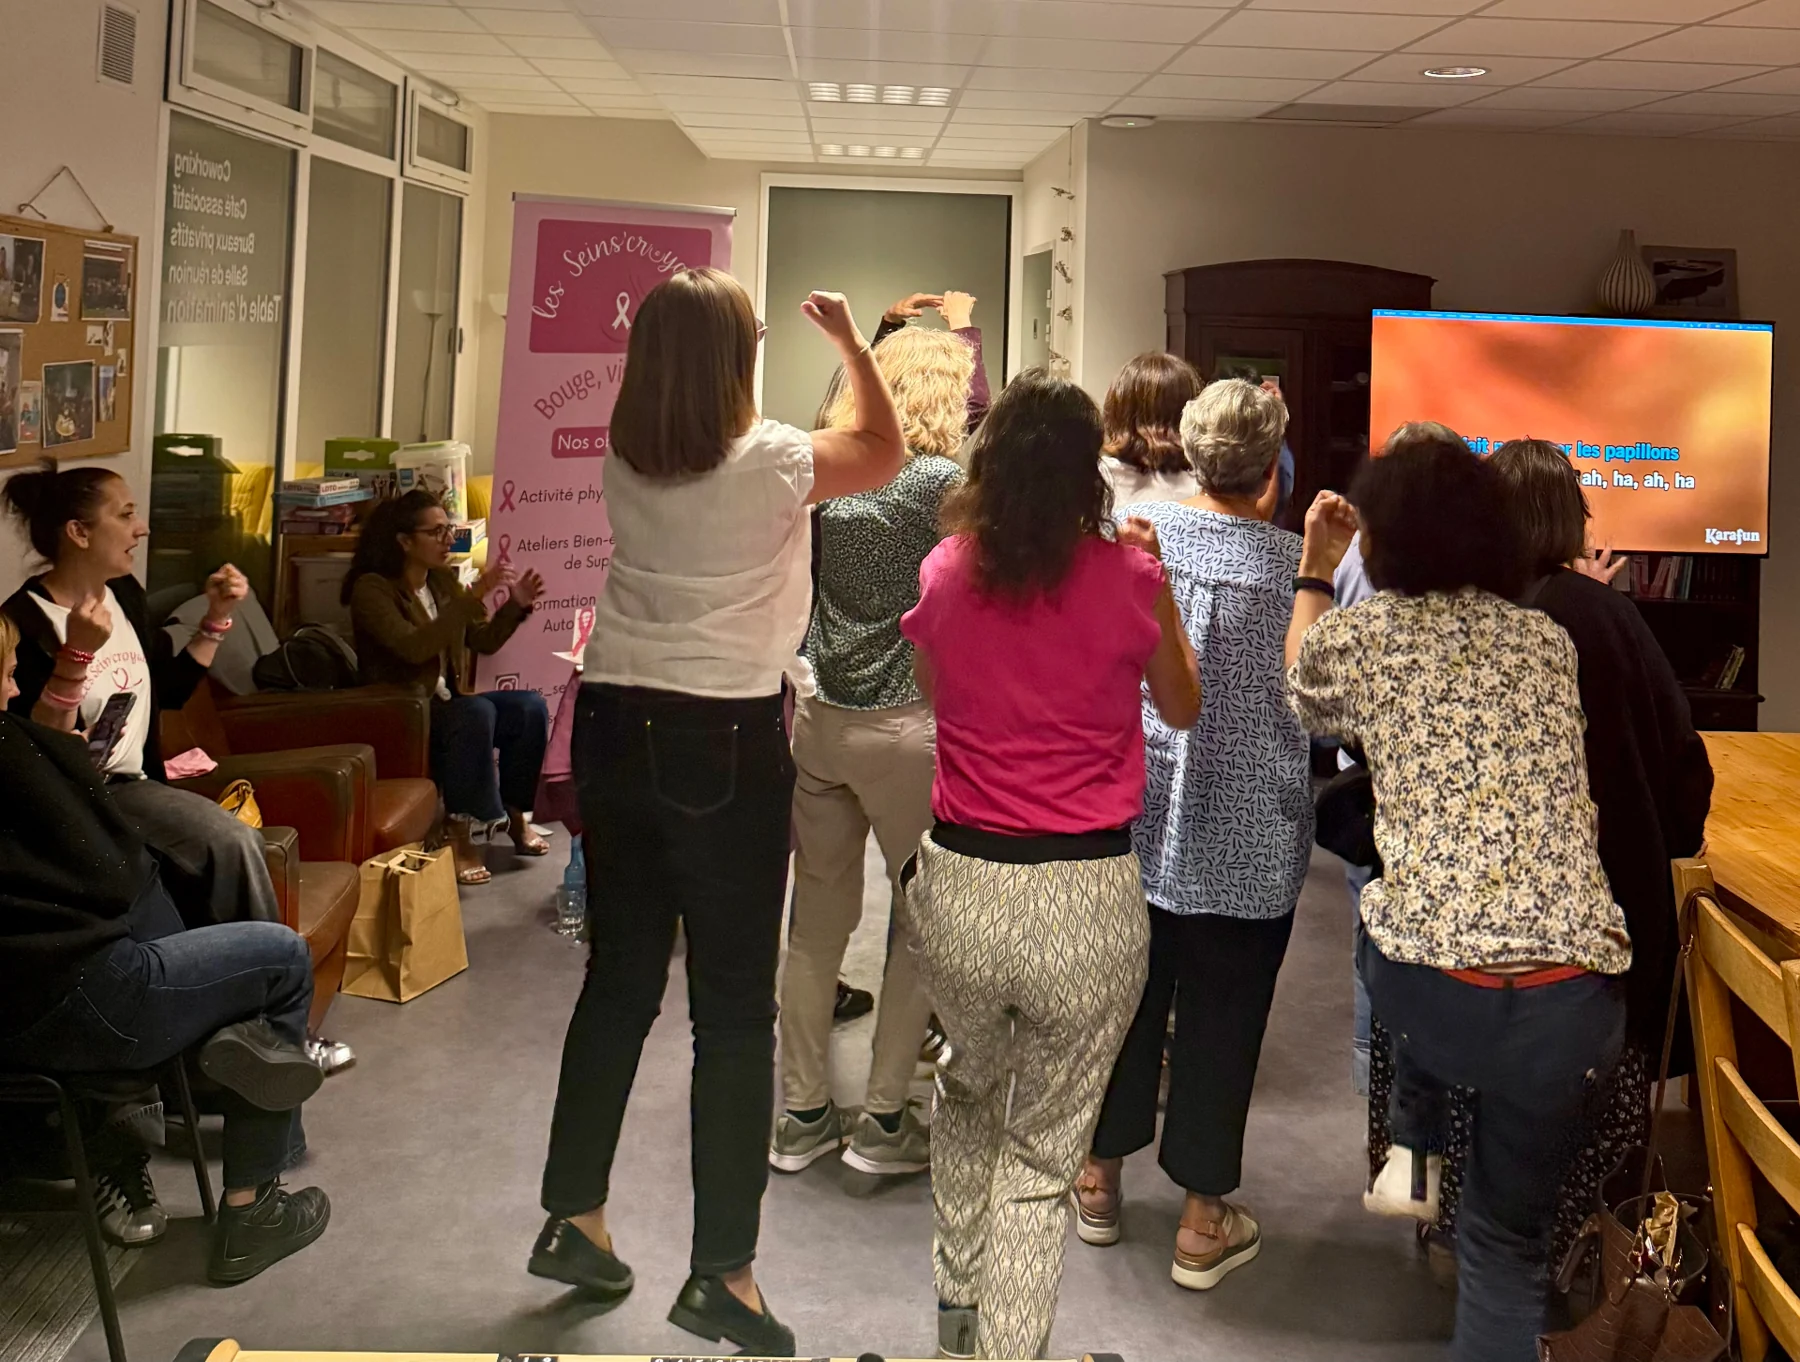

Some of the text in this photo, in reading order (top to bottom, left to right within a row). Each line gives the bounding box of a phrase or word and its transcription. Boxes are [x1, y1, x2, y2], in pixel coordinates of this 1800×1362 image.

[563, 231, 686, 277] Seins'croya
[533, 358, 623, 420] Bouge, vi
[558, 434, 589, 450] Nos
[1576, 440, 1601, 458] les
[1605, 442, 1680, 463] papillons
[321, 484, 338, 493] LOTO
[1581, 469, 1695, 491] ah, ha, ah, ha
[519, 484, 604, 504] Activité phy
[517, 534, 616, 552] Ateliers Bien-e
[1705, 528, 1760, 545] Karafun
[564, 554, 610, 571] de Sup
[532, 595, 596, 612] ormation
[543, 618, 574, 633] Auto
